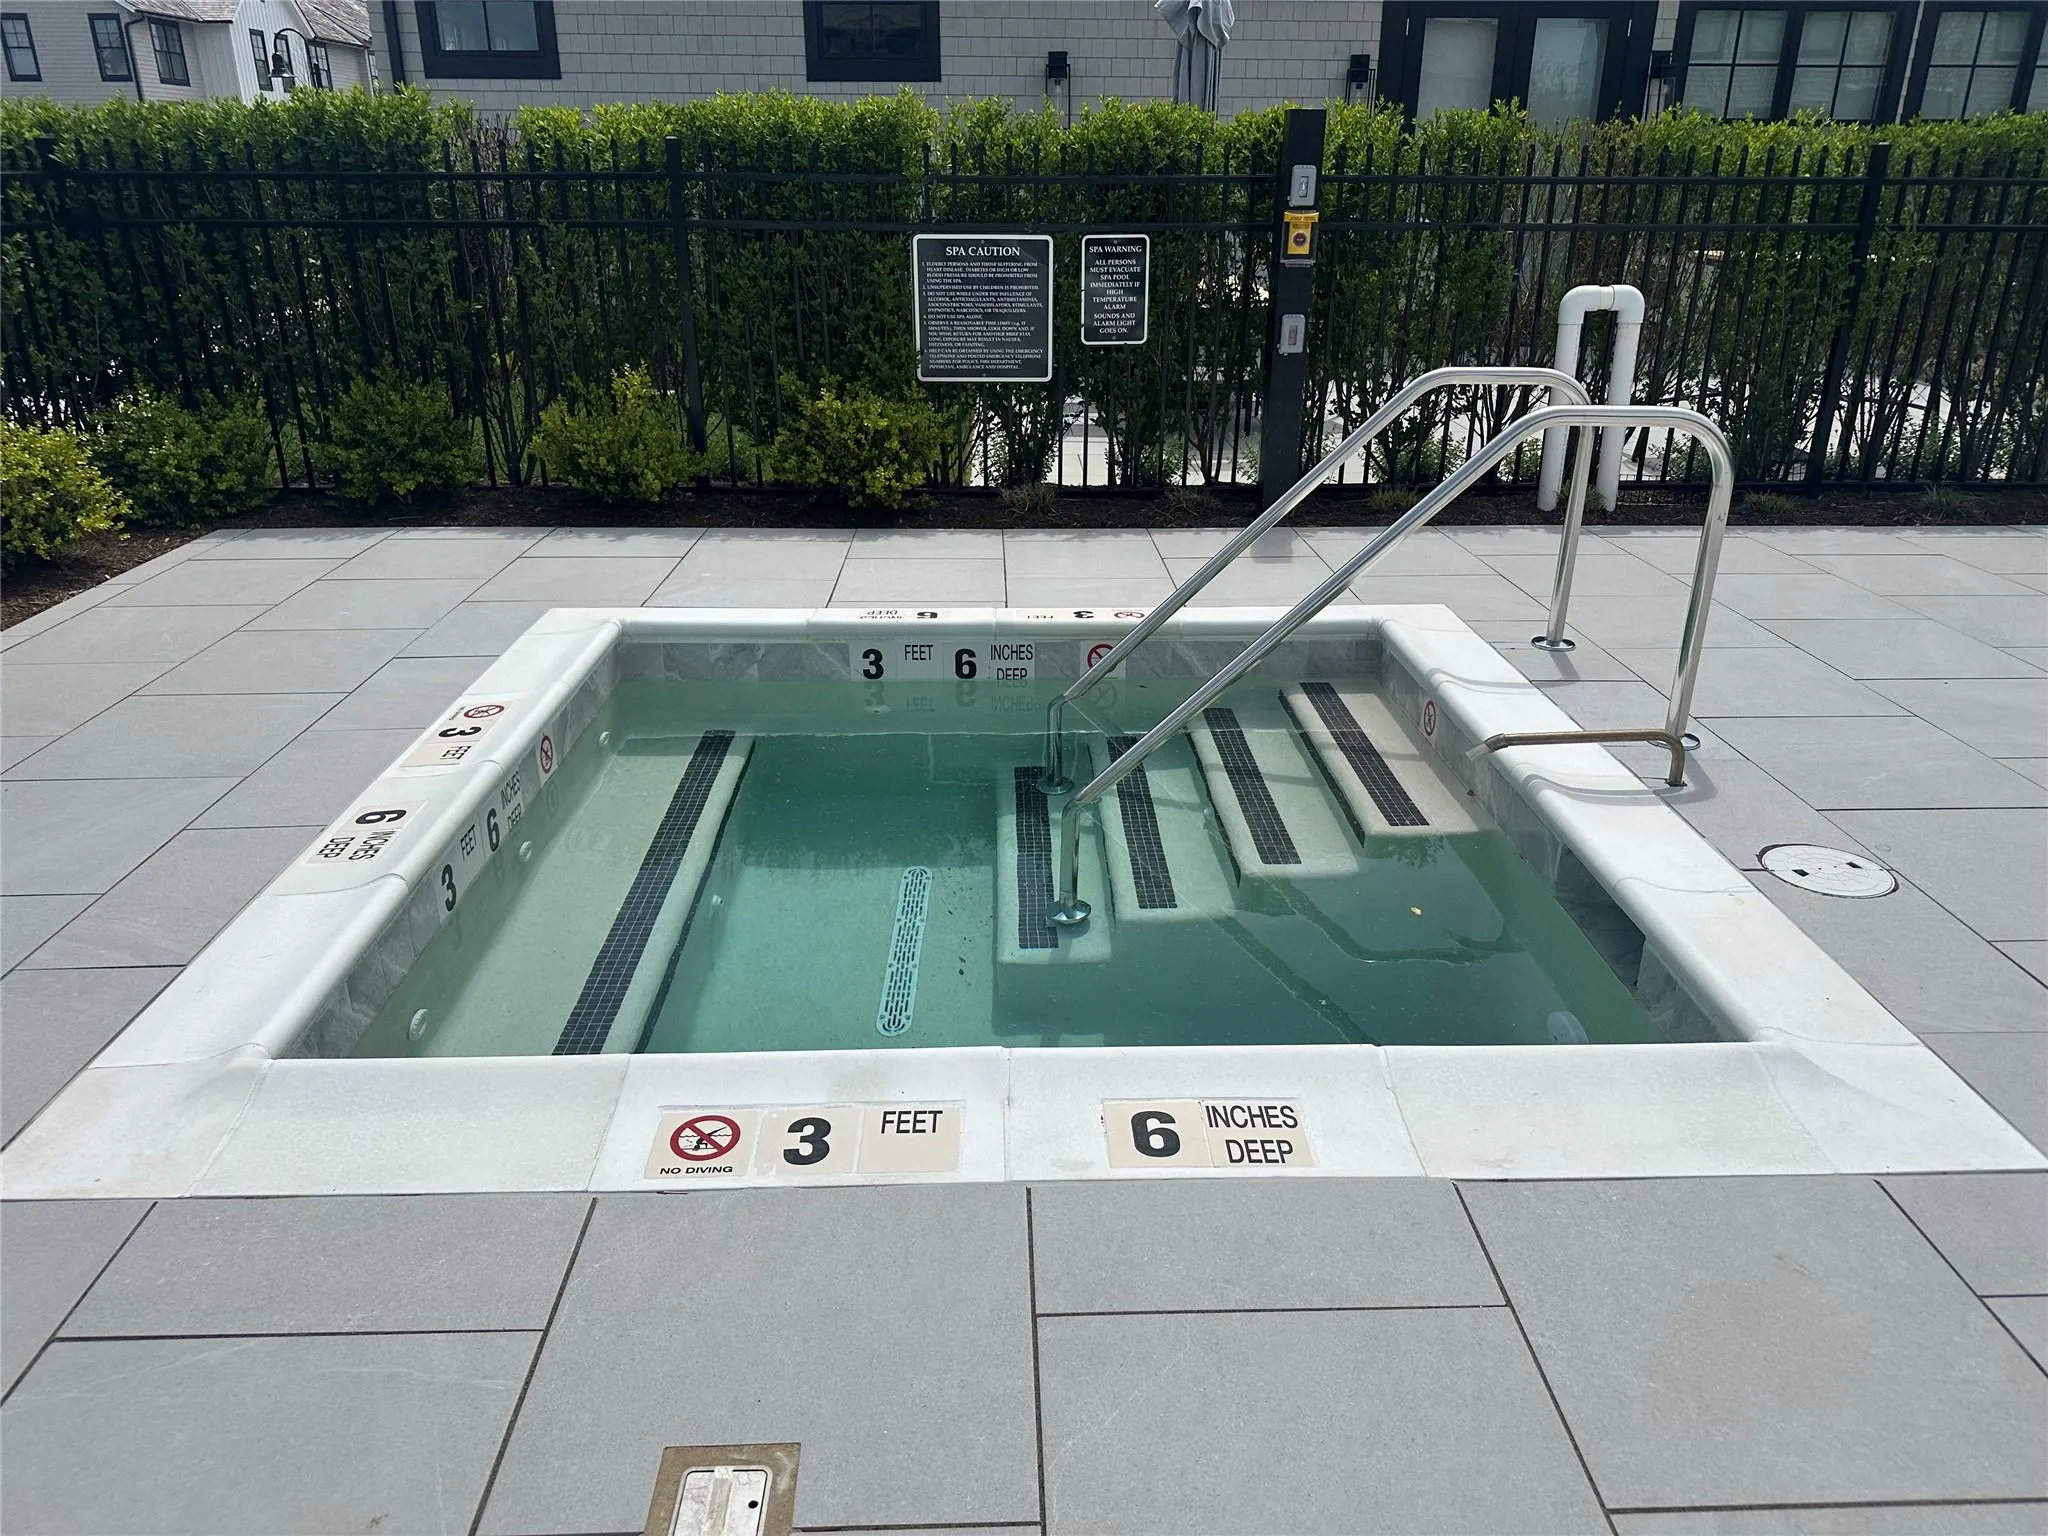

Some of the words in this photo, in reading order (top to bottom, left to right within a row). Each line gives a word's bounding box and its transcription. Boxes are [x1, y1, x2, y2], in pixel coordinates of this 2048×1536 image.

[946, 246, 966, 256] SPA
[968, 246, 1020, 256] CAUTION
[862, 648, 884, 680] 3
[904, 644, 934, 661] FEET
[954, 648, 977, 680] 6
[990, 644, 1033, 661] INCHES
[996, 668, 1028, 681] DEEP
[438, 726, 482, 738] 3
[440, 745, 472, 760] FEET
[355, 809, 407, 825] 6
[507, 804, 522, 833] DEEP
[316, 836, 356, 859] DEEP
[348, 830, 398, 861] INCHES
[441, 864, 457, 912] 3
[460, 823, 477, 861] FEET
[486, 807, 500, 852] 6
[500, 770, 521, 810] INCHES
[783, 1117, 832, 1166] 3
[880, 1110, 944, 1135] FEET
[1130, 1110, 1181, 1158] 6
[1204, 1104, 1299, 1129] INCHES
[1224, 1139, 1294, 1164] DEEP
[659, 1166, 682, 1175] NO
[685, 1165, 734, 1175] DIVING
